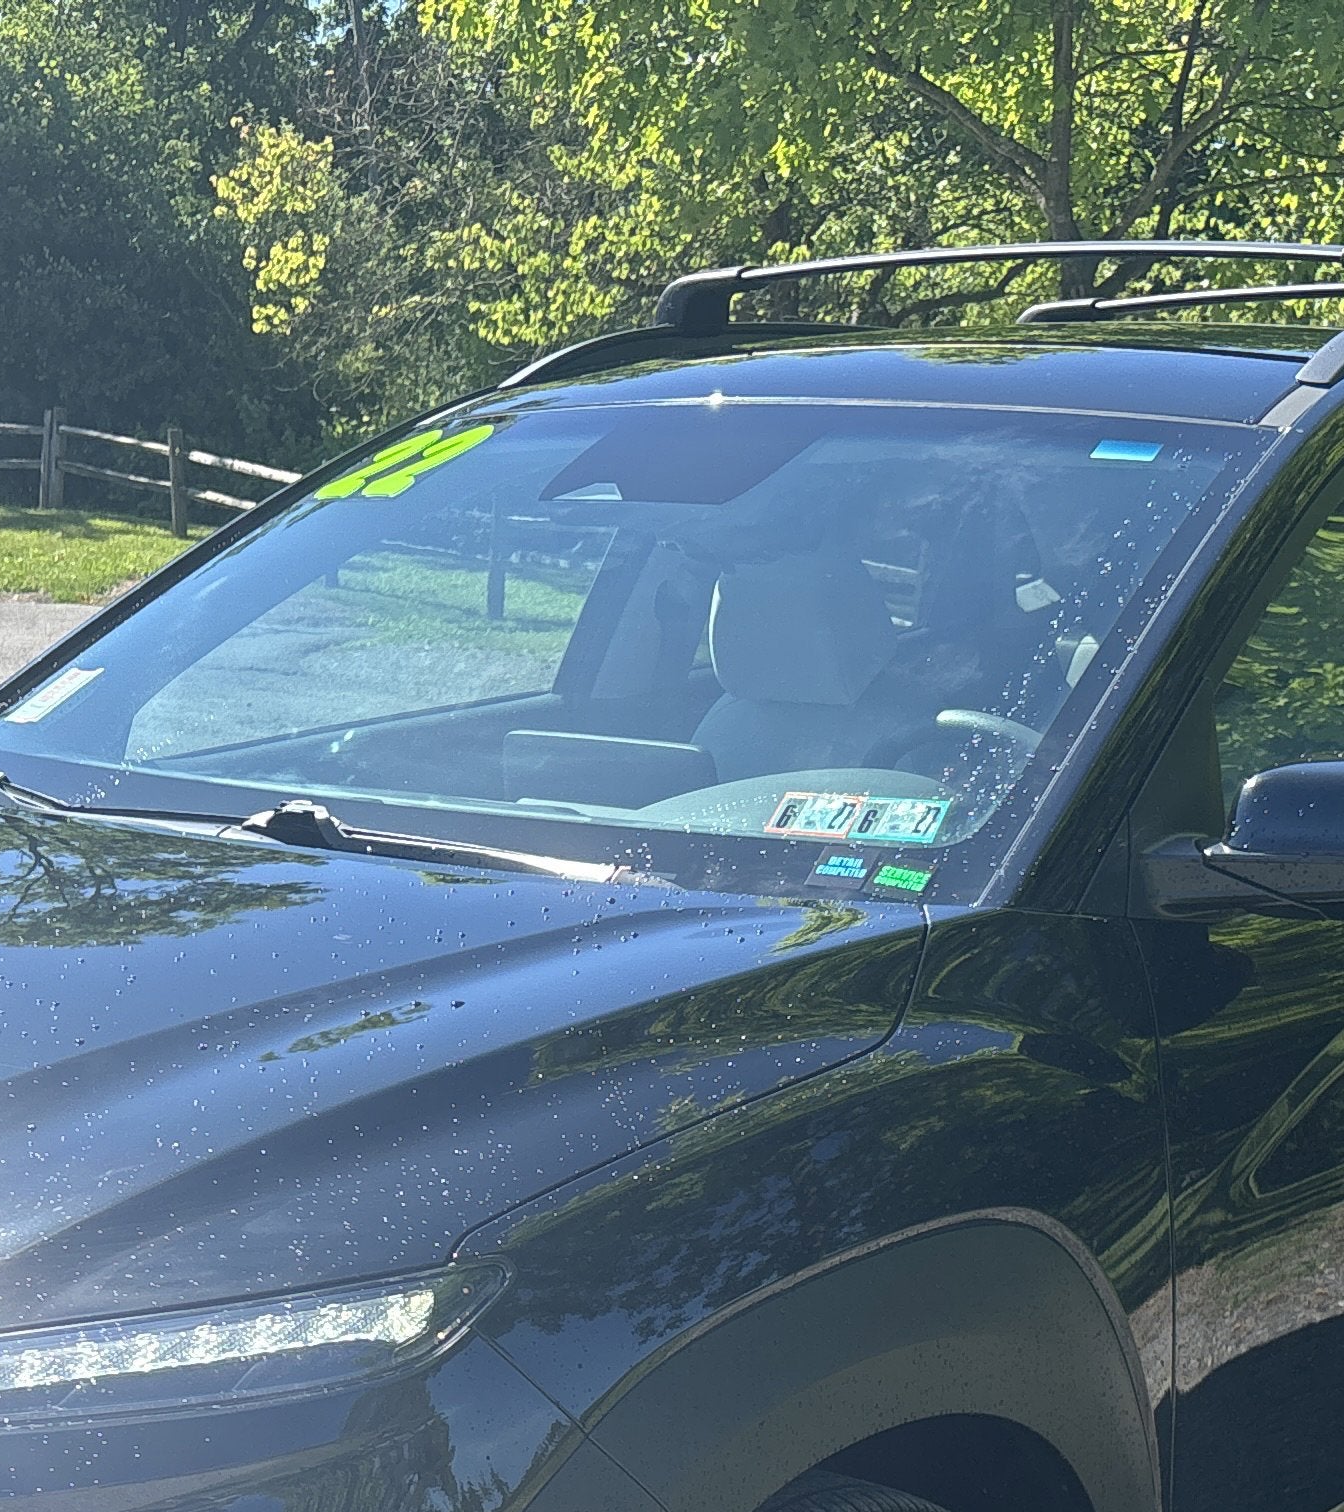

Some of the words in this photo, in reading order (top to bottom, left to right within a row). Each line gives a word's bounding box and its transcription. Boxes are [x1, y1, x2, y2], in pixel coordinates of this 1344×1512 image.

[313, 424, 495, 500] 22
[776, 804, 798, 829] 6
[857, 809, 879, 834] 6
[815, 865, 867, 878] COMPLETED
[828, 855, 864, 868] DETAIL
[880, 866, 932, 884] SERVICE
